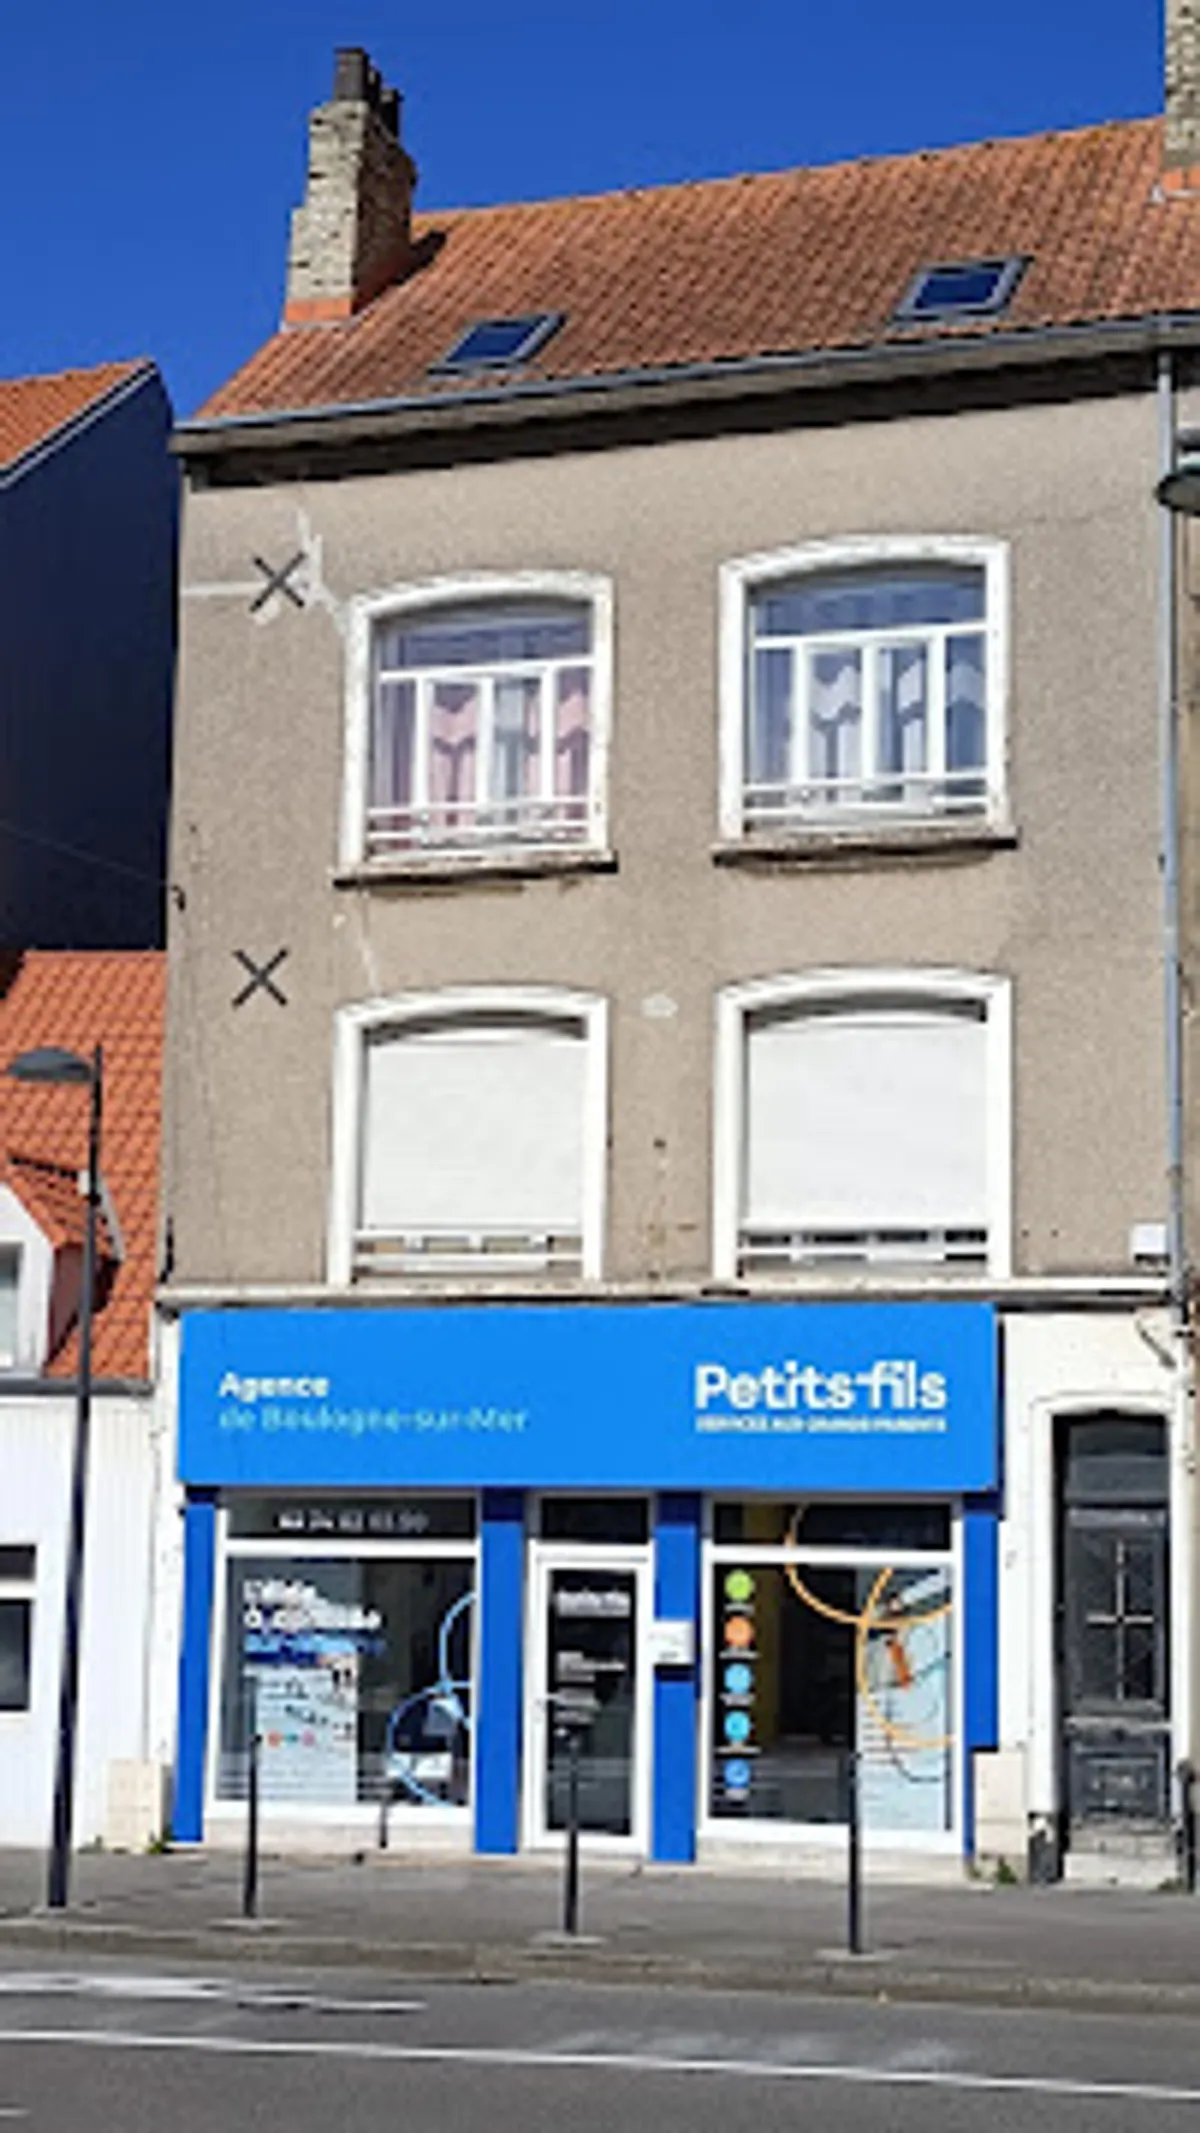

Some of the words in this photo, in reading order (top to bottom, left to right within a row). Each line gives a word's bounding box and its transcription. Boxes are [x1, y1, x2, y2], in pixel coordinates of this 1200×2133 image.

[219, 1372, 329, 1402] Agence
[695, 1360, 947, 1409] Petits-fils
[219, 1406, 255, 1431] de
[261, 1405, 527, 1436] Boulogne-sur-Mer
